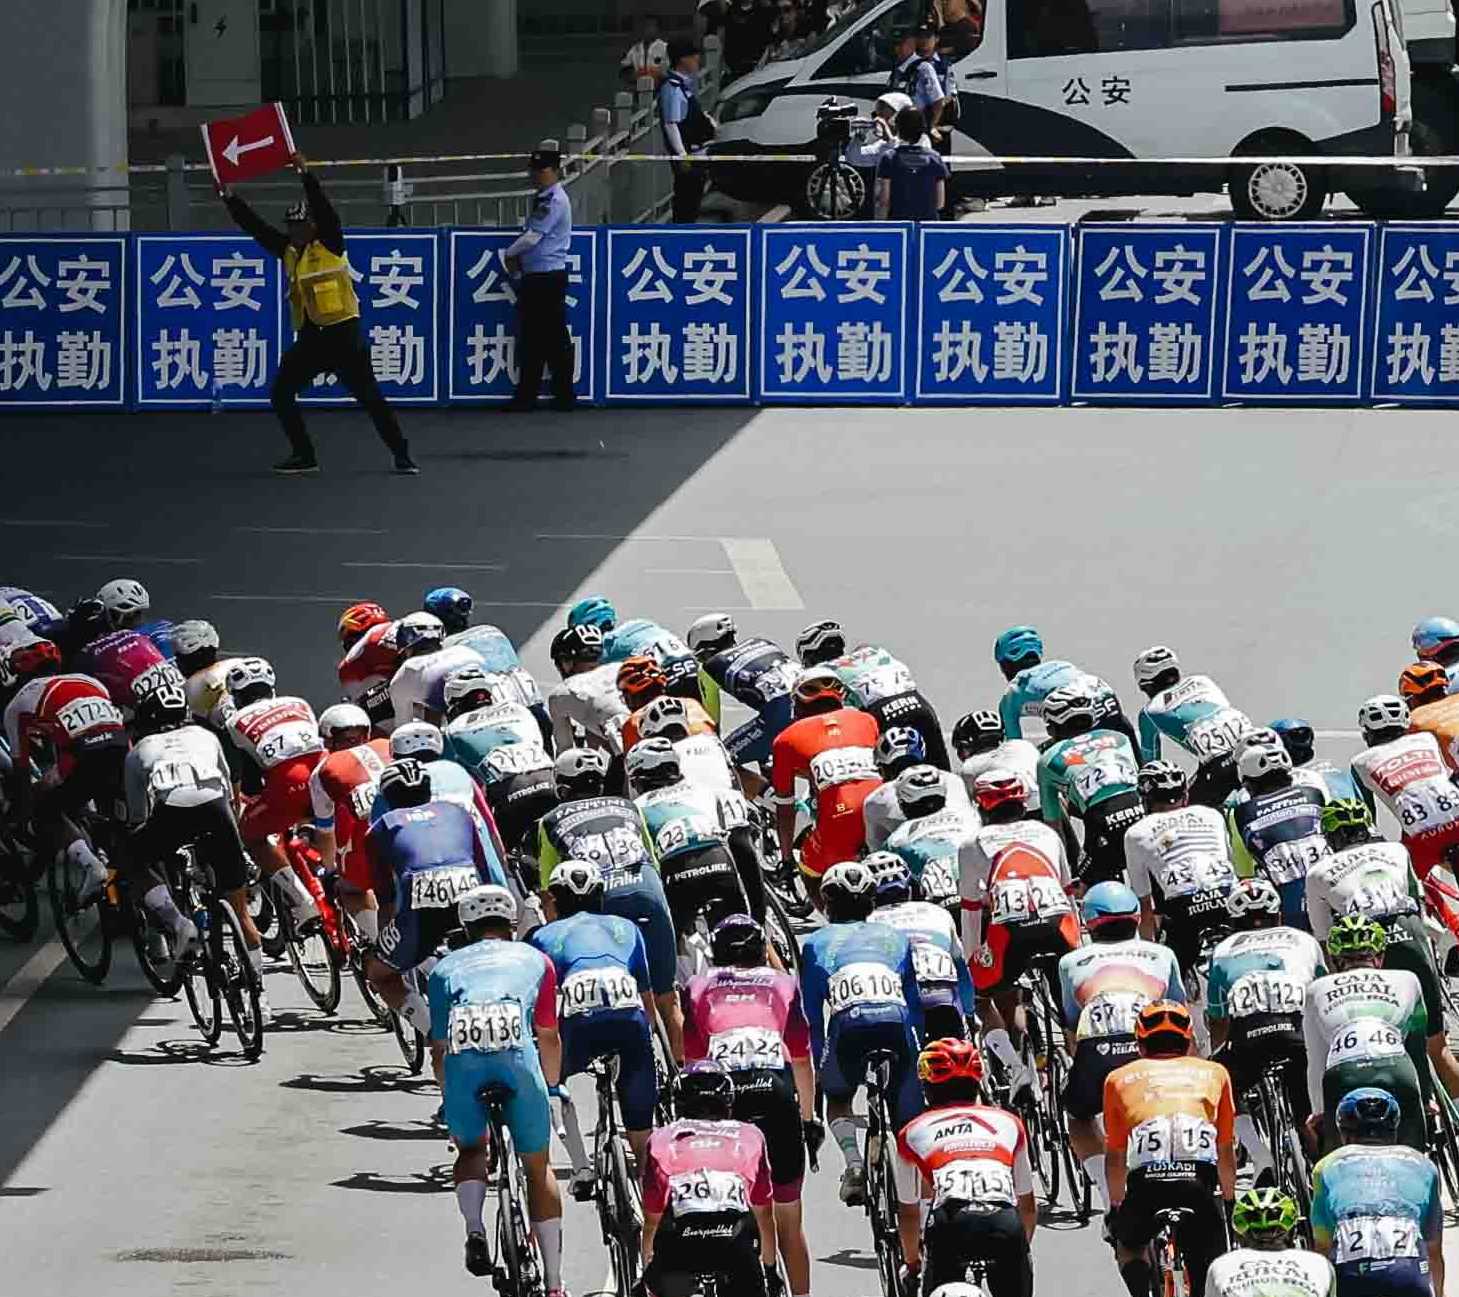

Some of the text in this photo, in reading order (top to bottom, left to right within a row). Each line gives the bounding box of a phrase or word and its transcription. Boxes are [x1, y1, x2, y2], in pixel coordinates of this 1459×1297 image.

[1062, 76, 1131, 105] 公安
[150, 252, 266, 311] 公安
[625, 247, 739, 306] 公安
[777, 243, 893, 304] 公安
[934, 245, 1050, 306] 公安
[1095, 245, 1207, 305] 公安
[1245, 245, 1355, 306] 公安
[151, 328, 269, 389] 执勤
[623, 324, 739, 385] 执勤
[777, 322, 893, 381] 执勤
[934, 321, 1050, 383] 执勤
[1090, 322, 1204, 381] 执勤
[1239, 325, 1351, 383] 执勤
[881, 697, 919, 718] KERN
[1105, 804, 1144, 824] KERN
[1402, 806, 1428, 826] 83
[675, 863, 730, 881] PETROLIKE
[717, 1038, 781, 1060] 24 24
[1332, 1031, 1397, 1053] 46 46
[934, 1123, 973, 1142] ANTA
[677, 1182, 707, 1201] 26
[1349, 1229, 1408, 1251] 2 2
